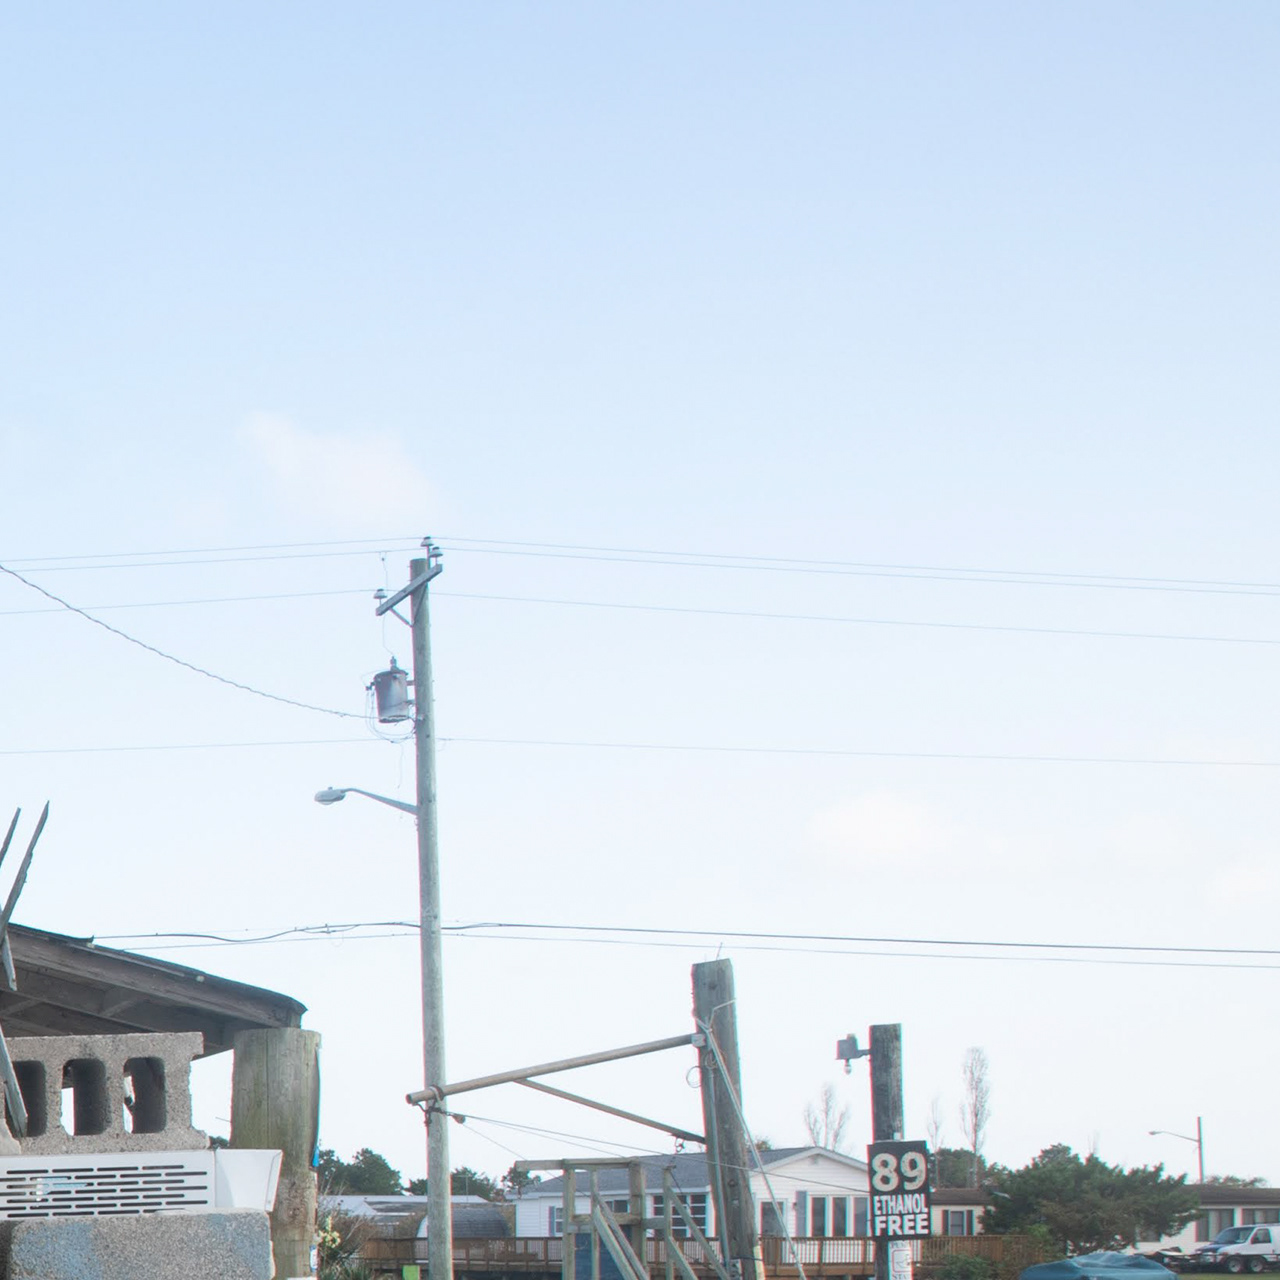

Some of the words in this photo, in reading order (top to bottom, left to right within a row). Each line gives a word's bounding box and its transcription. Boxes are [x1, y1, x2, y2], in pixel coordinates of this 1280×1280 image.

[871, 1151, 928, 1192] 89
[873, 1193, 928, 1215] ETHANOL
[874, 1214, 930, 1236] FREE
